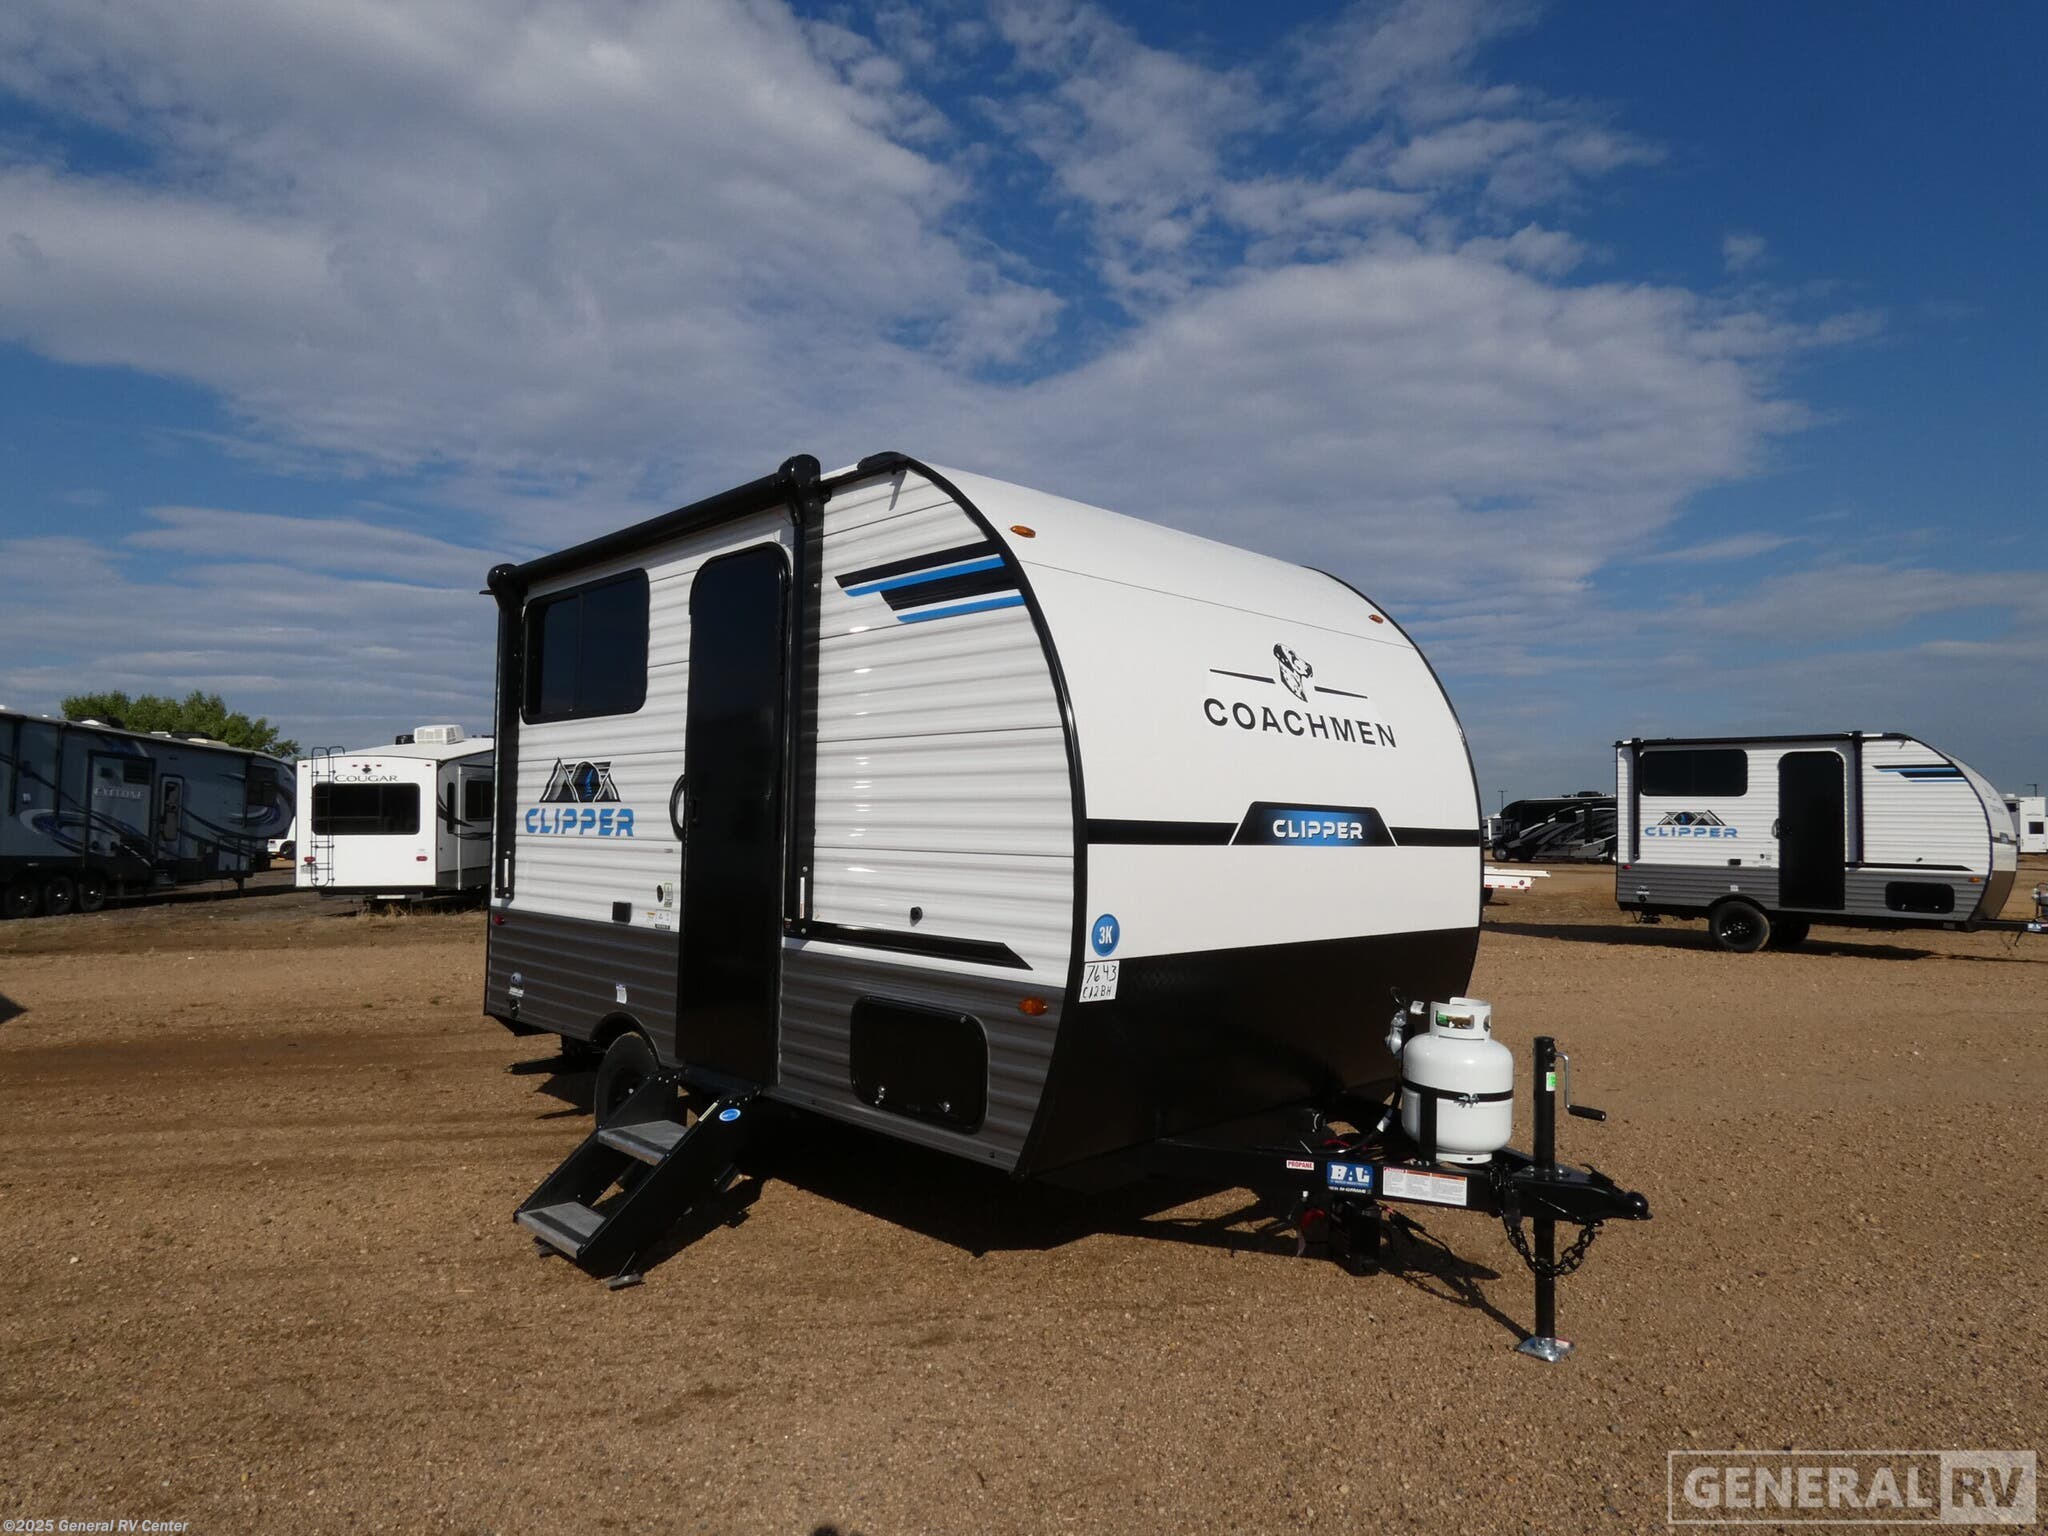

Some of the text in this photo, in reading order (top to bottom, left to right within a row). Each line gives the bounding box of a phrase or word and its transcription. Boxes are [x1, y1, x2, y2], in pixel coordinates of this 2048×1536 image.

[1203, 697, 1397, 748] COACHMEN
[334, 774, 399, 783] COUGAR
[525, 808, 634, 837] CLIPPER
[1272, 819, 1364, 840] CLIPPER
[1644, 826, 1739, 839] CLIPPER
[1098, 926, 1113, 945] 3K
[1086, 964, 1118, 984] 7643
[1287, 1161, 1313, 1169] PROPANE
